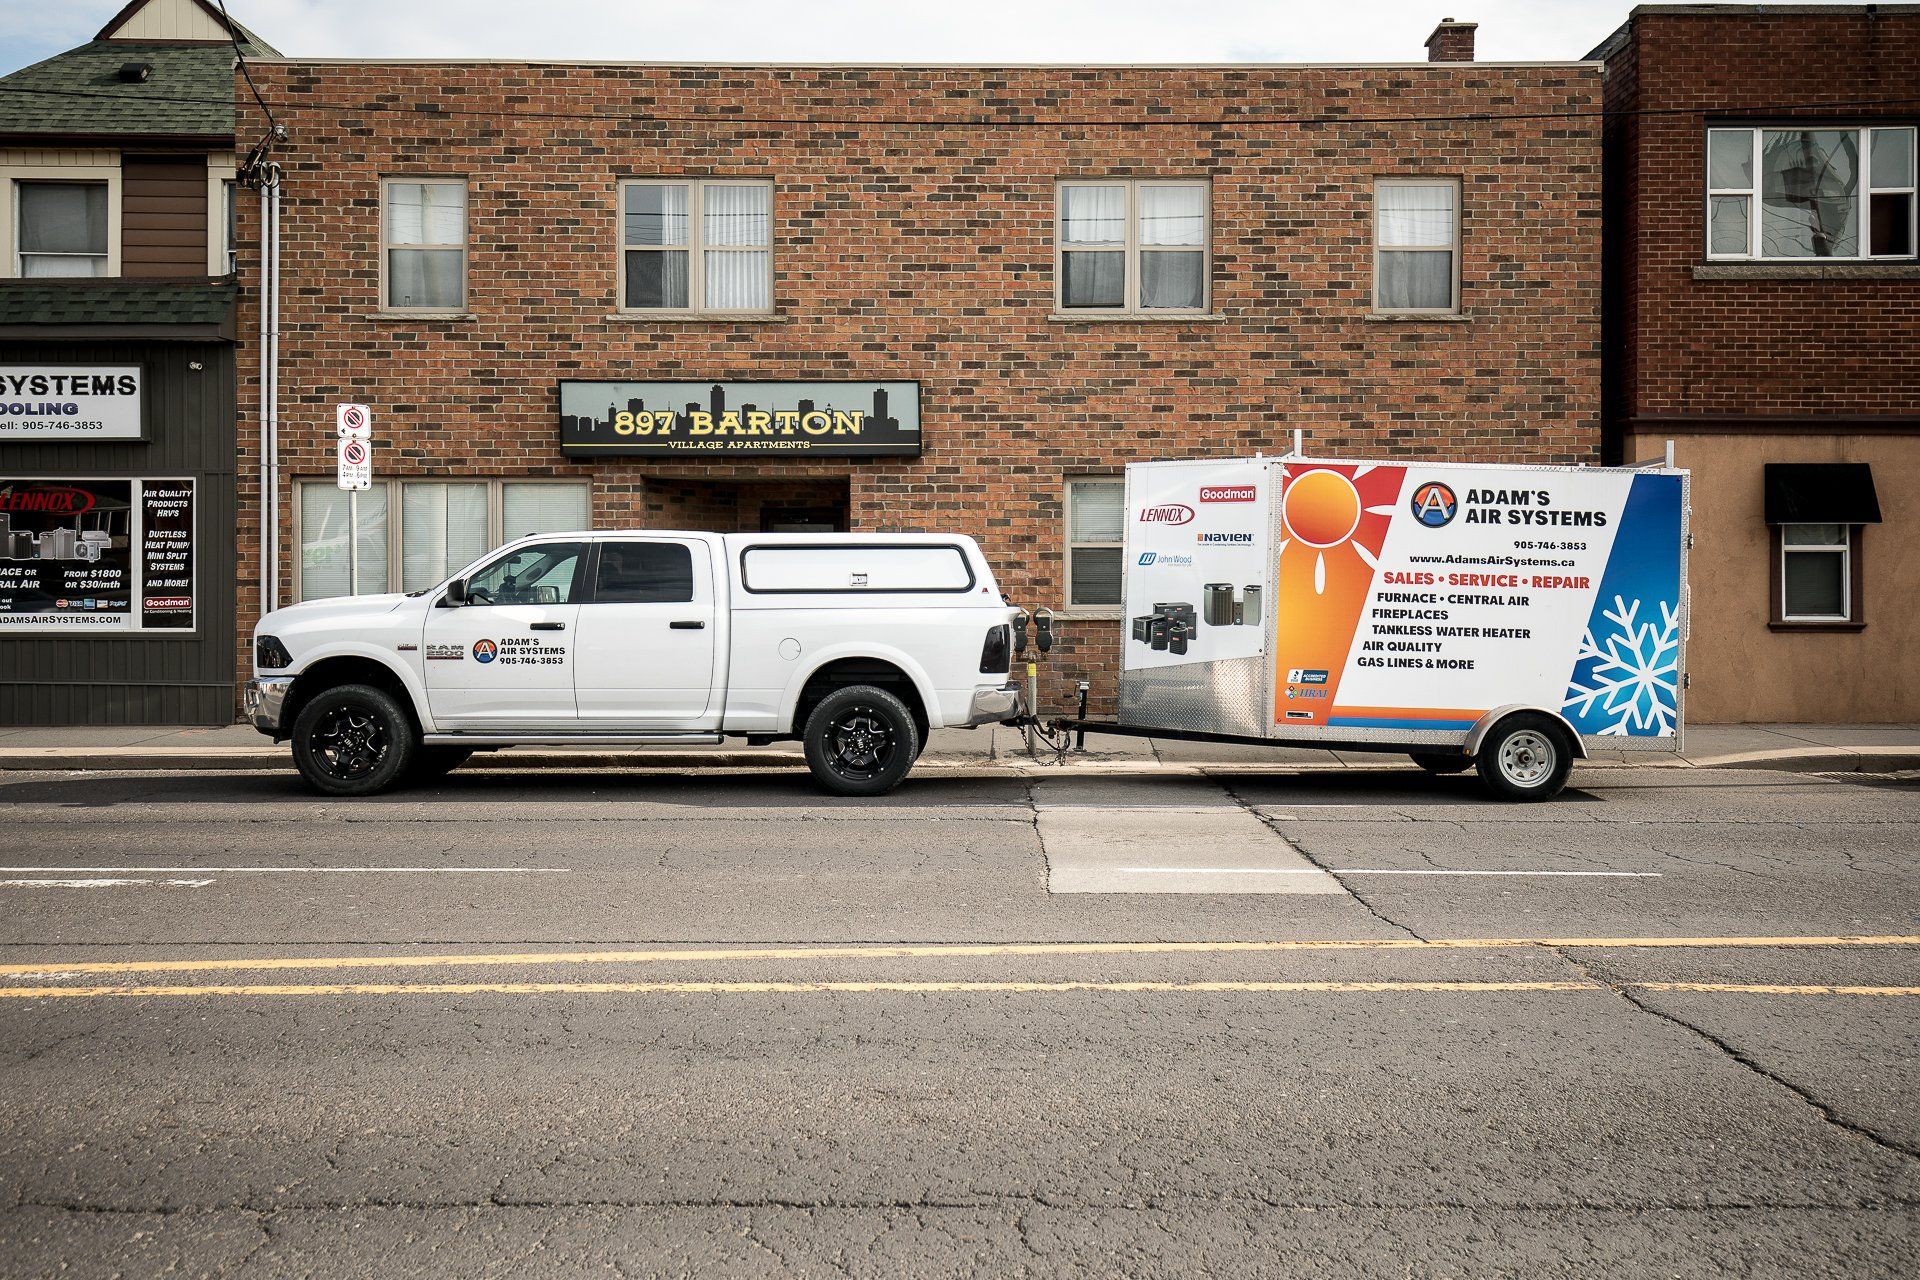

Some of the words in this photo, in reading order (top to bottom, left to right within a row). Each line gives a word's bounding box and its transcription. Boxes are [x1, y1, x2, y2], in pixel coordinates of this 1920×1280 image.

[22, 421, 103, 430] 905-746-3853
[614, 410, 675, 435] 897
[689, 410, 865, 435] BARTON
[668, 441, 724, 450] VILLAGE
[727, 440, 811, 450] APARTMENTS
[143, 489, 157, 498] AIR
[158, 489, 193, 498] QUALITY
[1201, 488, 1254, 499] Goodman
[1465, 488, 1551, 507] ADAM'S
[147, 500, 188, 508] PRODUCTS
[1139, 508, 1185, 522] LENNOX
[1465, 508, 1501, 524] AIR
[1508, 509, 1607, 527] SYSTEMS
[148, 530, 187, 538] DUCTLESS
[144, 541, 166, 549] HEAT
[1513, 541, 1587, 550] 905-746-3853
[146, 551, 165, 560] MINI
[166, 551, 188, 560] SPLIT
[1157, 555, 1173, 564] John
[1173, 555, 1192, 564] Wood
[1409, 555, 1575, 567] www.AdamsAirSystems.ca
[150, 562, 185, 571] SYSTEMS
[0, 568, 22, 576] ACE
[90, 569, 122, 578] $1800
[20, 579, 40, 589] AIR
[79, 580, 121, 589] $30/mth
[146, 579, 163, 587] AND
[164, 579, 189, 587] MORE!
[1383, 571, 1435, 584] SALES
[1448, 573, 1518, 587] SERVICE
[1532, 575, 1590, 589] REPAIR
[146, 599, 190, 607] Goodman
[1377, 592, 1437, 604] FURNACE
[1447, 594, 1505, 606] CENTRAL
[1507, 596, 1530, 606] AIR
[1372, 608, 1449, 620] FIREPLACES
[1372, 625, 1433, 636] TANKLESS
[1436, 626, 1480, 637] WATER
[1482, 627, 1531, 639] HEATER
[500, 638, 540, 646] ADAM'S
[500, 646, 518, 655] AIR
[519, 646, 566, 655] SYSTEMS
[1362, 641, 1385, 651] AIR
[1387, 641, 1443, 653] QUALITY
[499, 657, 564, 665] 905-746-3853
[1357, 657, 1385, 667] GAS
[1387, 658, 1424, 669] LINES
[1425, 658, 1435, 669] &
[1436, 659, 1475, 670] MORE
